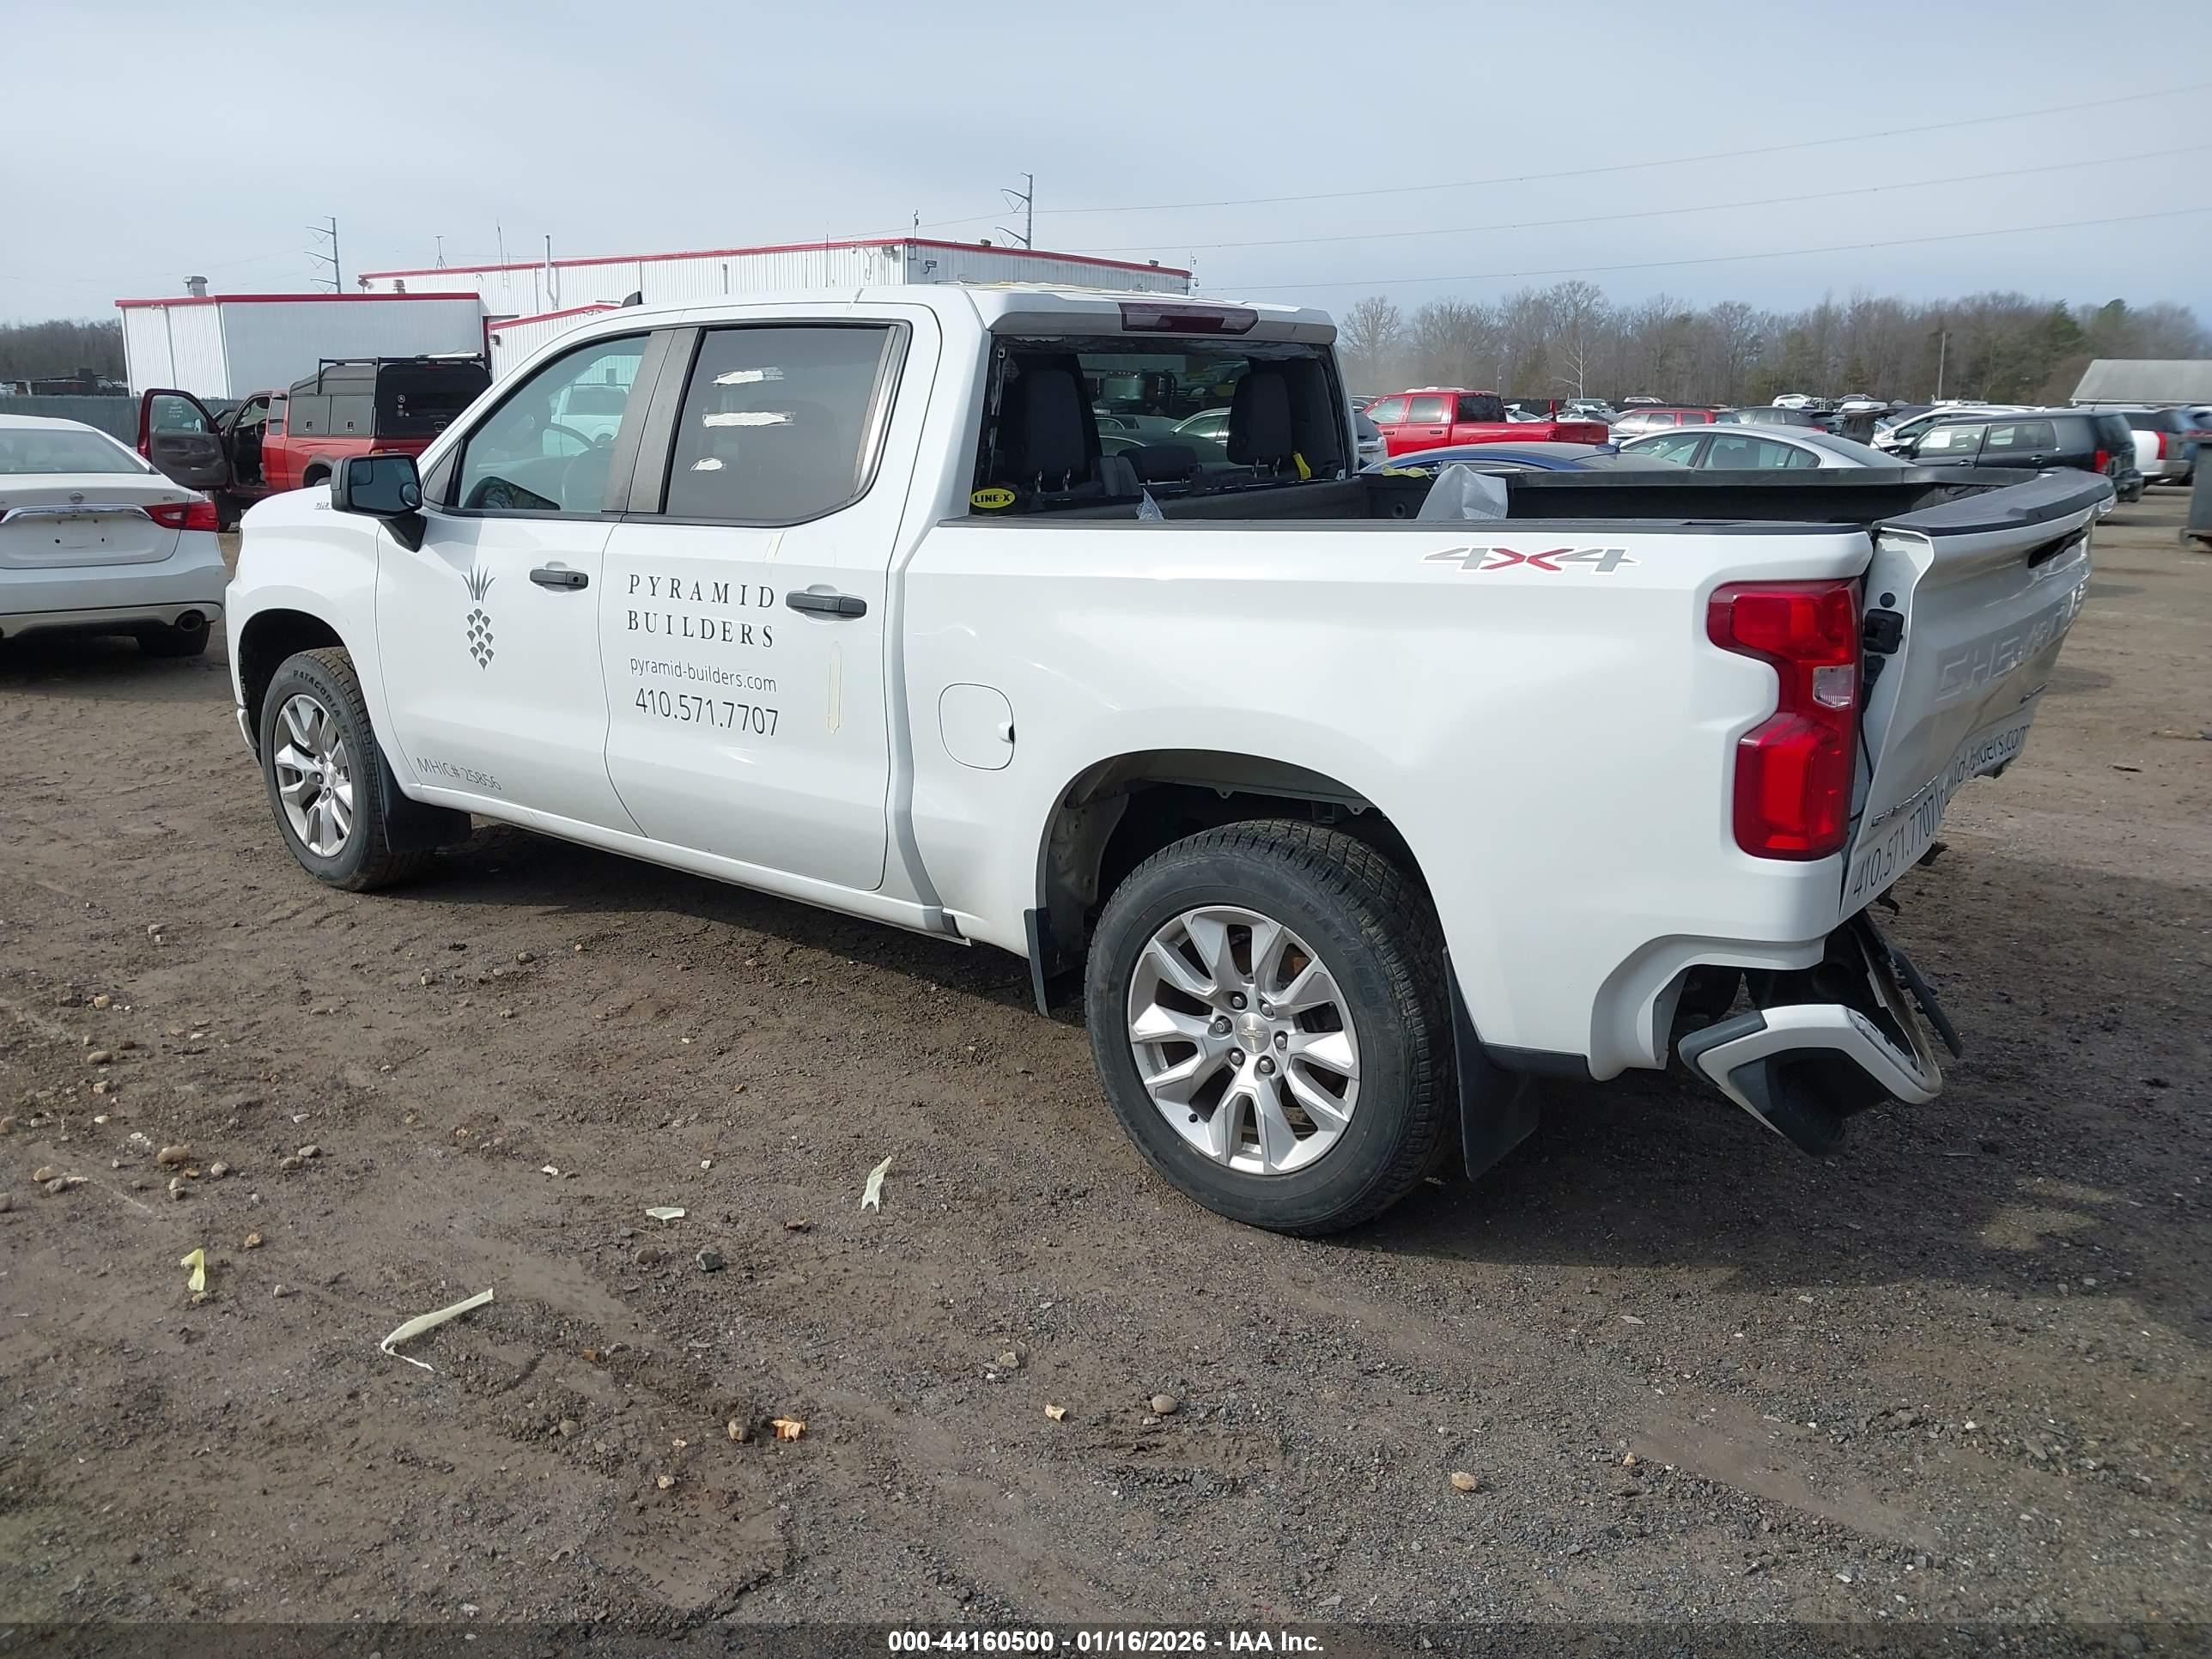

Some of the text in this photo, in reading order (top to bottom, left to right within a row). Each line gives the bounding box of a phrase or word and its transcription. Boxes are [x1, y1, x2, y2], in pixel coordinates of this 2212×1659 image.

[974, 493, 1012, 503] LINE-X
[1423, 547, 1638, 573] 4X4
[629, 574, 775, 608] PYRAMID
[627, 610, 774, 648] BUILDERS
[629, 657, 777, 693] pyramid-builders.com
[635, 688, 779, 736] 410.571.7707
[1853, 794, 1935, 899] 410.571.7707
